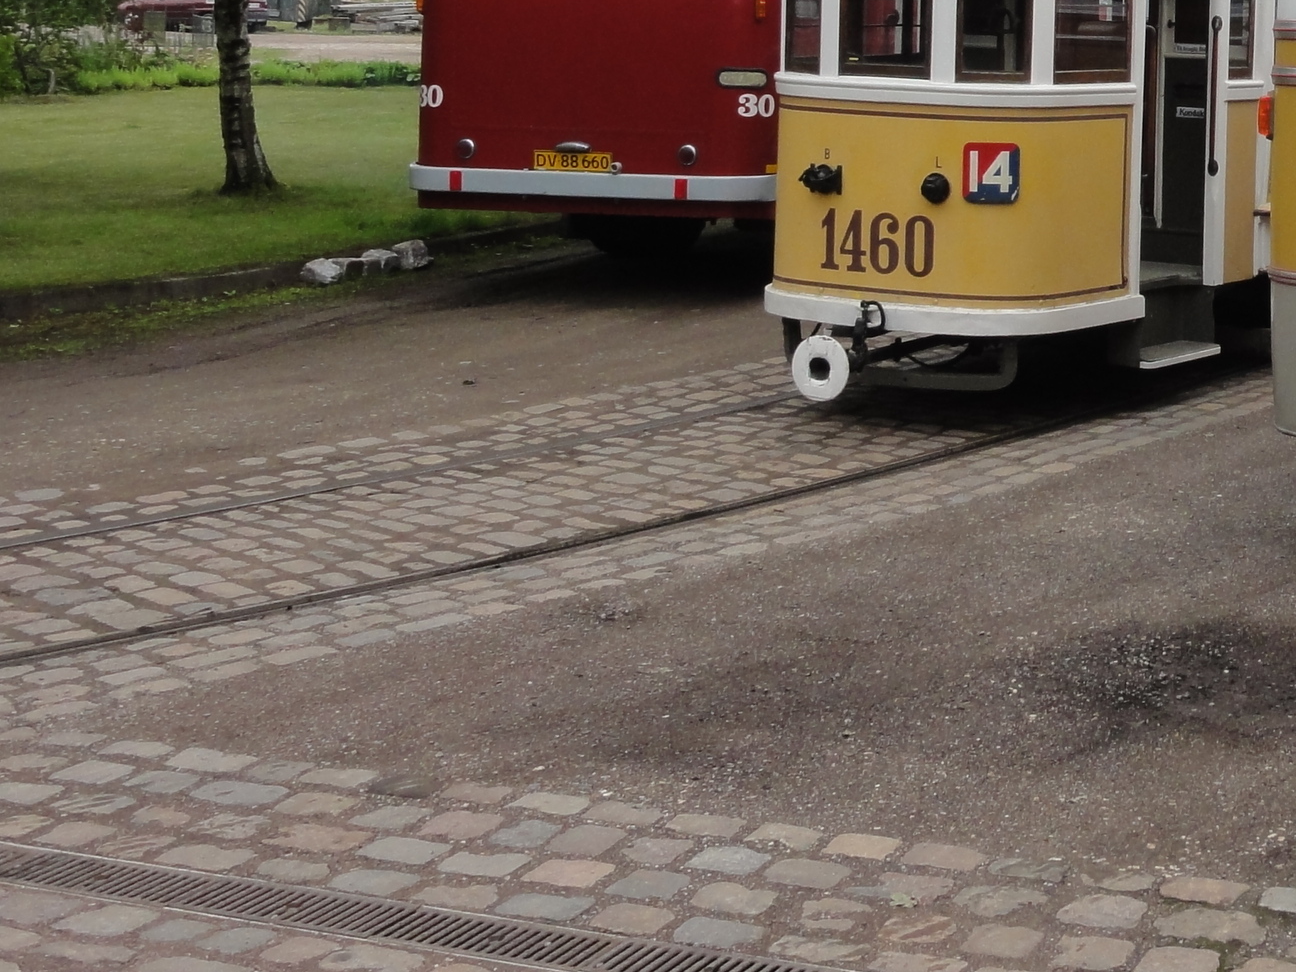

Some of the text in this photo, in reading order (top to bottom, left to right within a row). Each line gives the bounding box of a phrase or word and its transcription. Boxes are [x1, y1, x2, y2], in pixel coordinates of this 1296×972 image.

[737, 93, 775, 117] 30
[536, 154, 609, 170] DV 88 660
[825, 148, 830, 160] B
[935, 156, 942, 169] L
[969, 150, 1013, 193] 14
[820, 207, 935, 278] 1460
